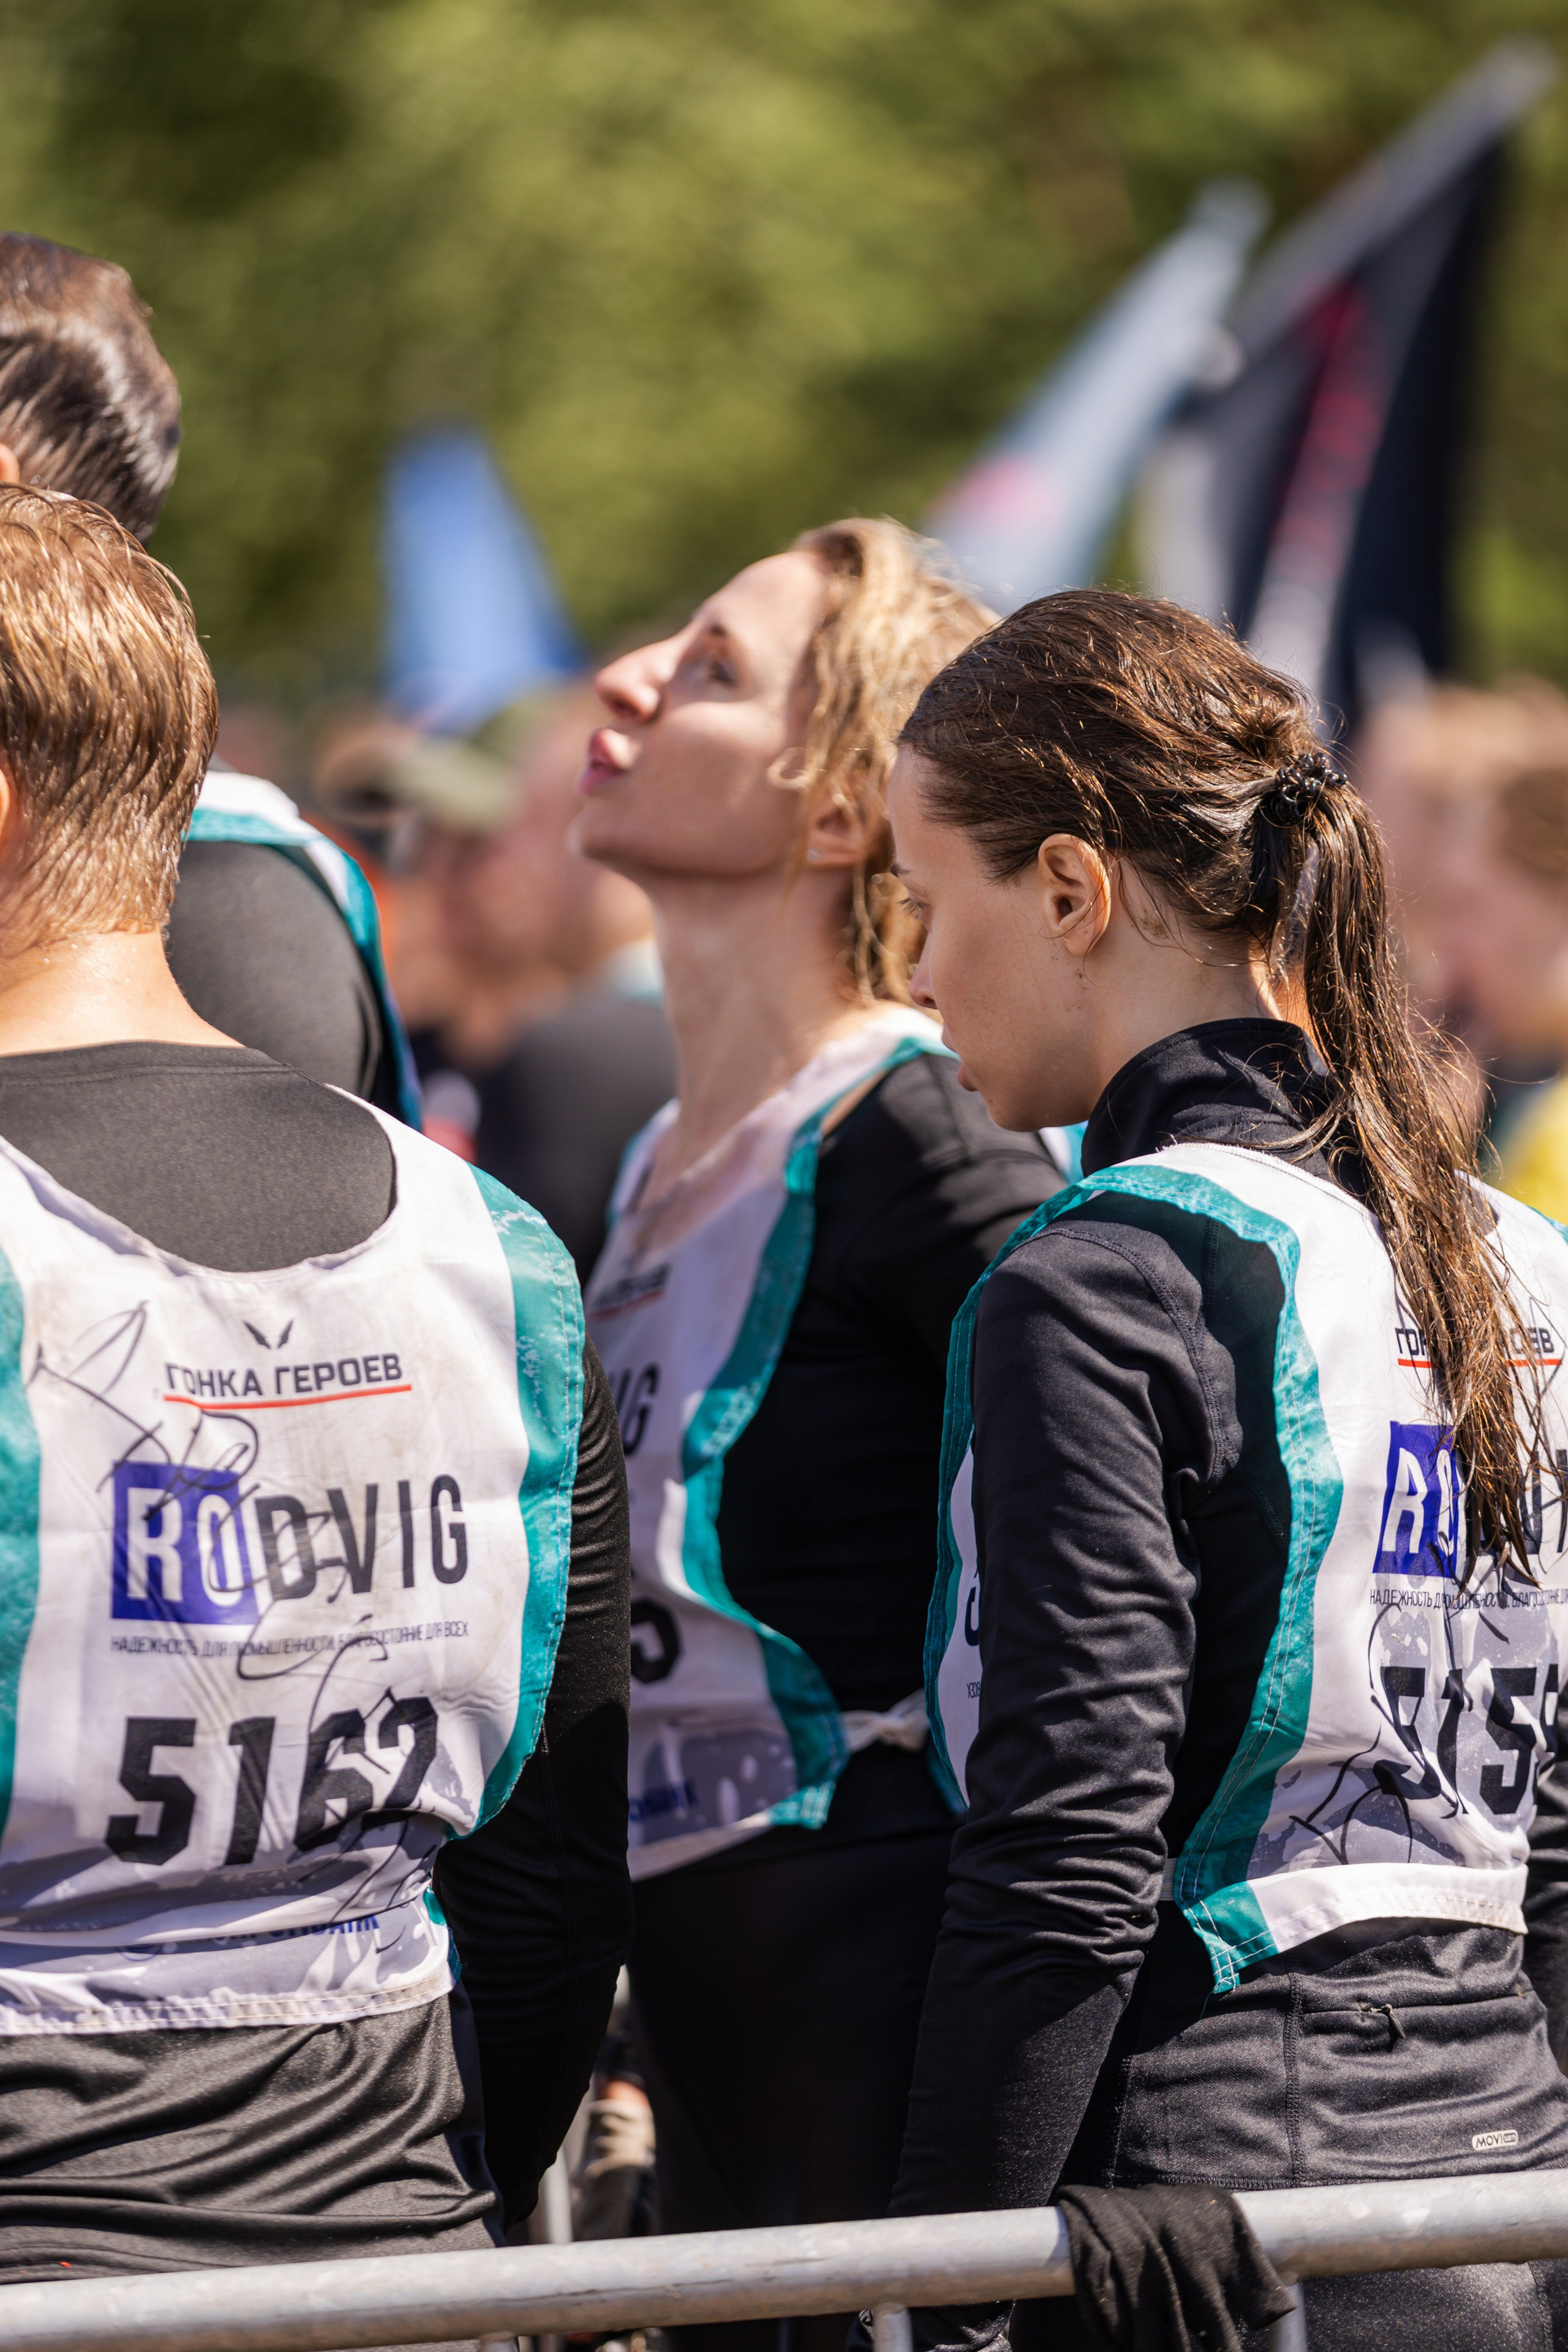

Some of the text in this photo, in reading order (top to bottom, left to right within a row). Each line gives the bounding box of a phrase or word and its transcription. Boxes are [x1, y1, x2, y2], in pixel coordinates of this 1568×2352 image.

[165, 1352, 403, 1397] ГОНКА ГЕРОЕВ
[126, 1474, 469, 1607] RODVIG
[1370, 1589, 1432, 1607] НАДЕЖНОСТЬ
[444, 1621, 469, 1637] ВСЕХ
[105, 1696, 439, 1866] 5162
[1476, 2133, 1502, 2148] MOVI
